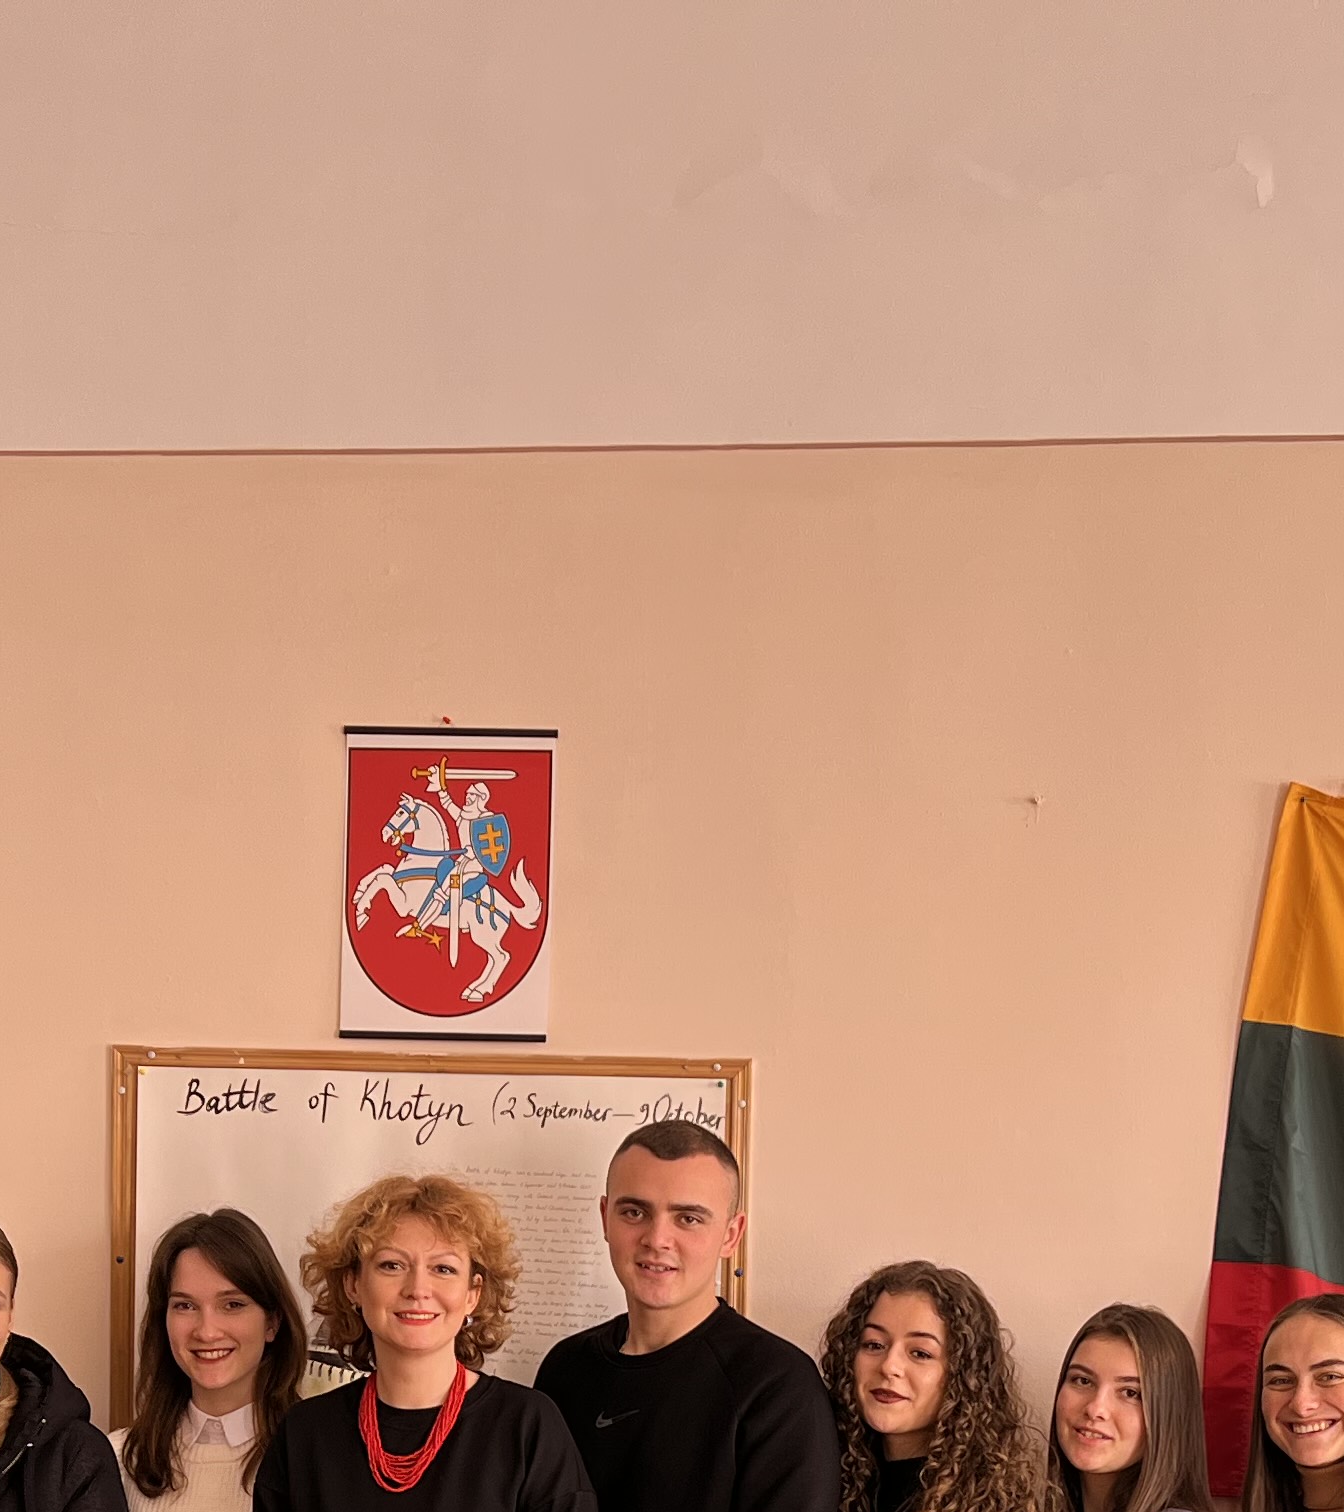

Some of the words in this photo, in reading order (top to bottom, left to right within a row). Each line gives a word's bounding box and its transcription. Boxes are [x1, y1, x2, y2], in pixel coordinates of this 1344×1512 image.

[176, 1078, 278, 1115] Battle
[308, 1081, 339, 1123] of
[359, 1078, 473, 1146] Khotyn
